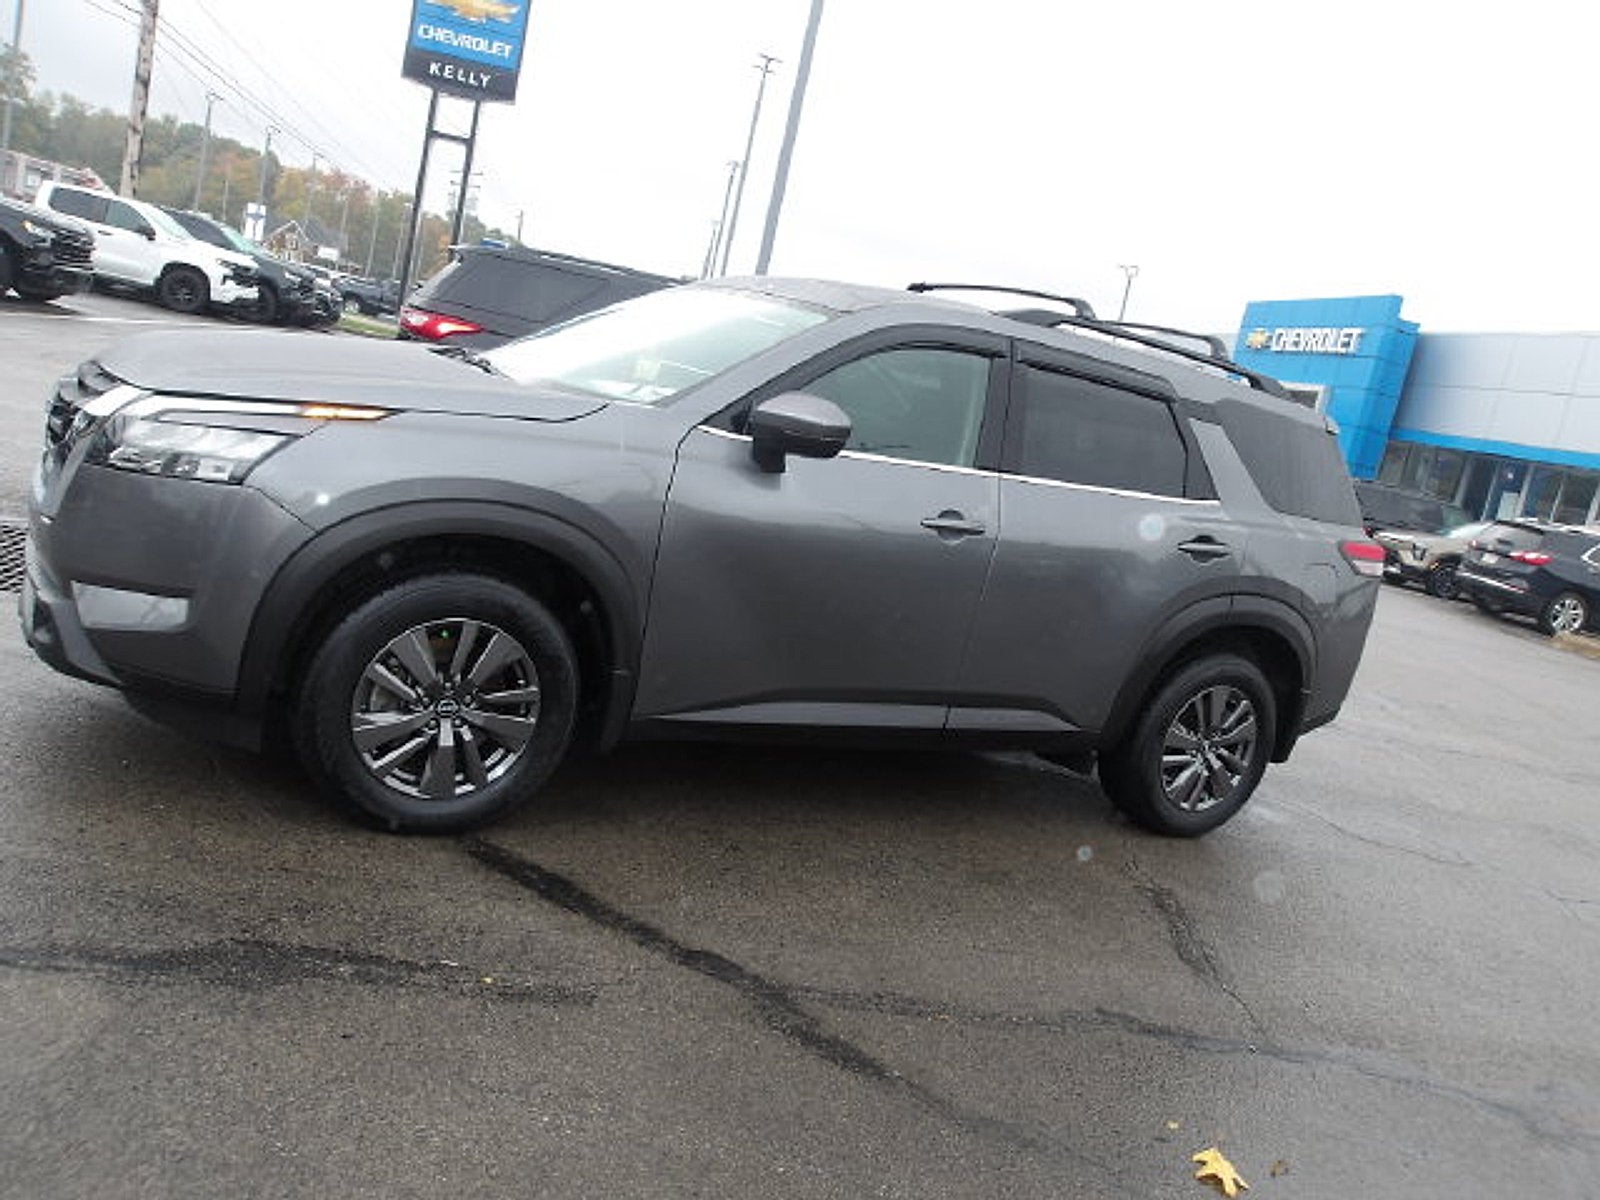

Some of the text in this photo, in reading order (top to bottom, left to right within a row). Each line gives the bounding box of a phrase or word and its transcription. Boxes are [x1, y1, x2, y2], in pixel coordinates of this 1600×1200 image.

[418, 25, 512, 58] CHEVROLET
[430, 62, 491, 87] KELLY
[1272, 328, 1363, 352] CHEVROLET
